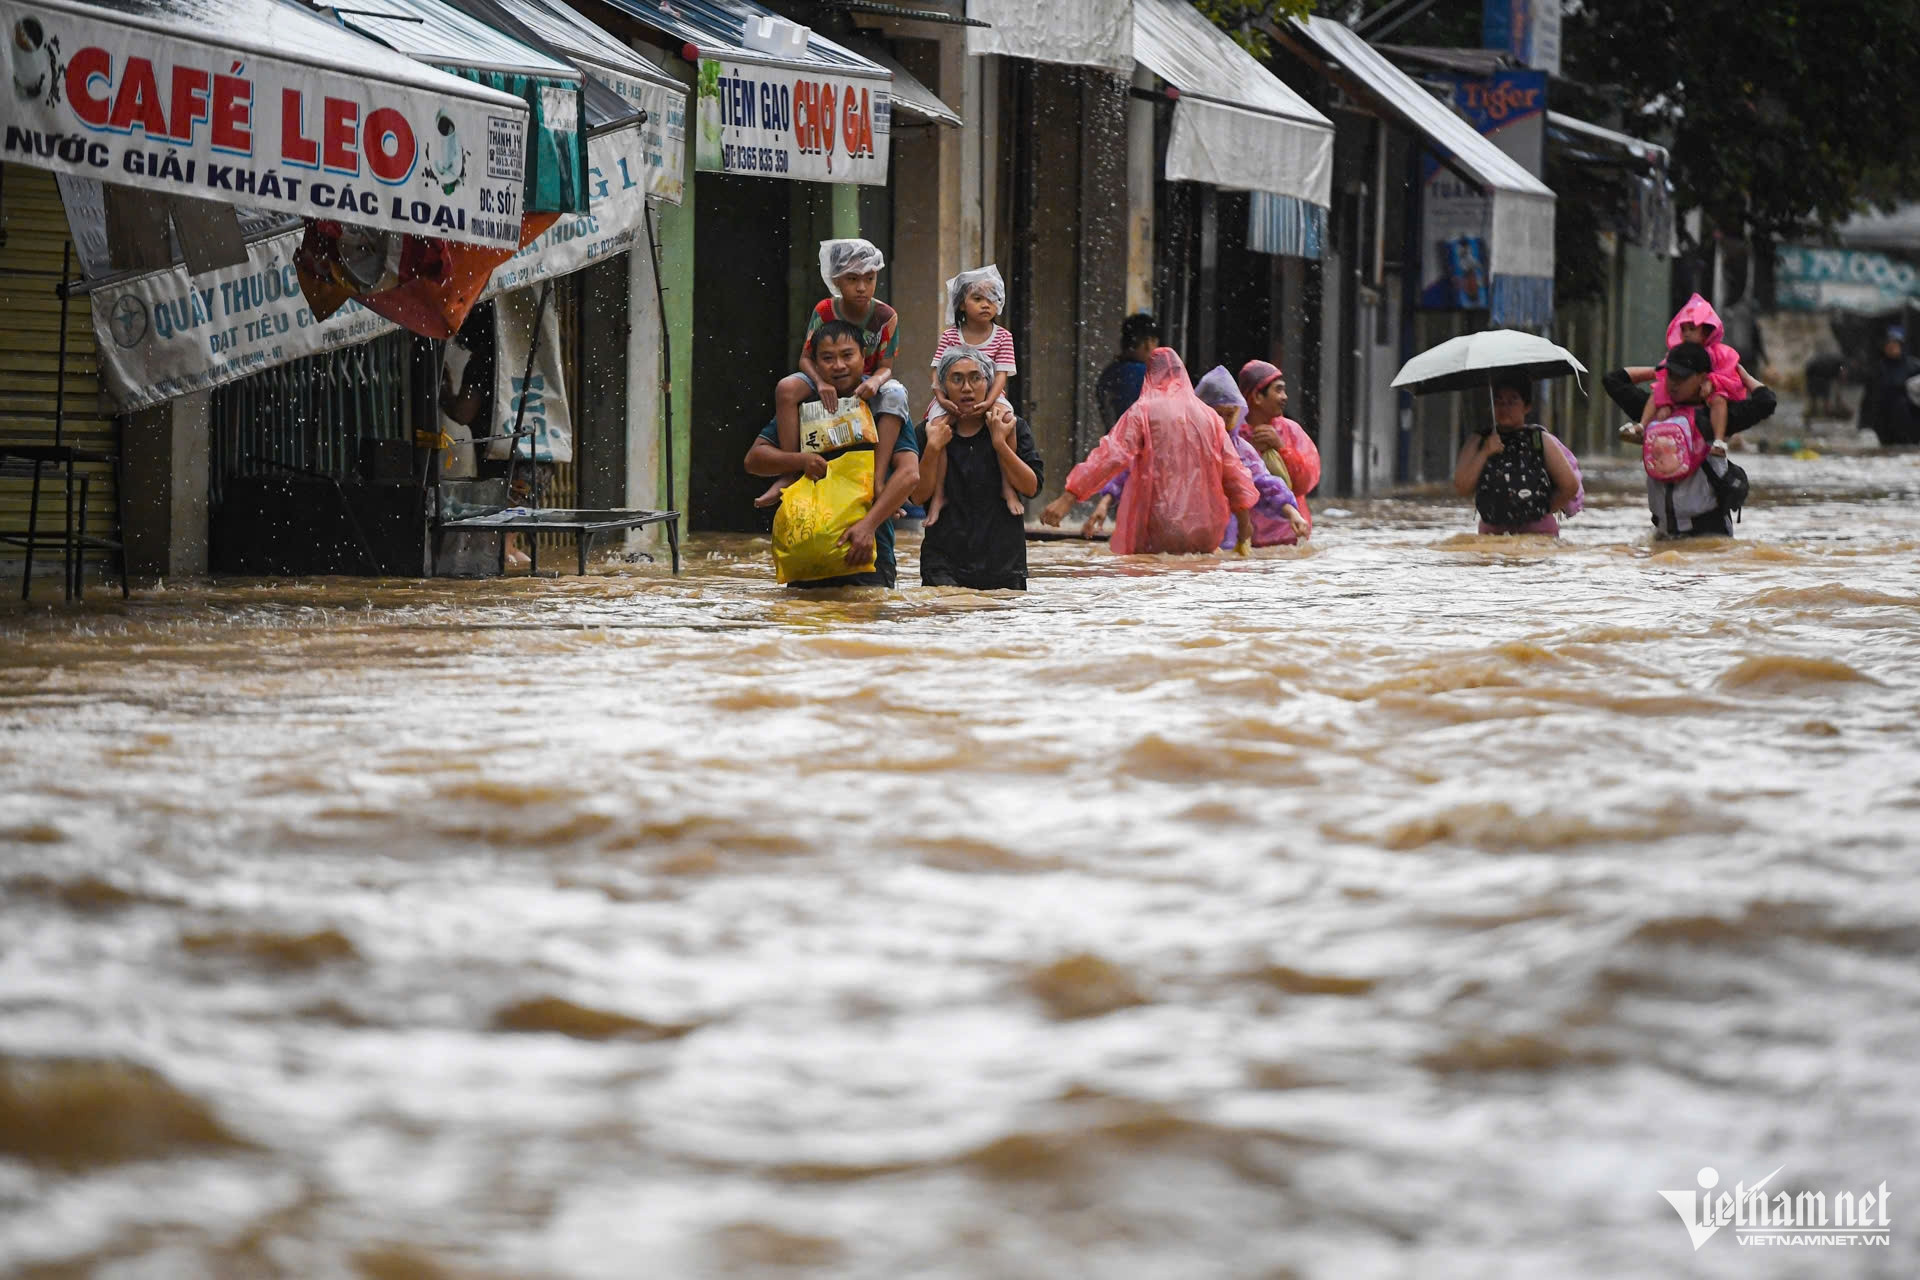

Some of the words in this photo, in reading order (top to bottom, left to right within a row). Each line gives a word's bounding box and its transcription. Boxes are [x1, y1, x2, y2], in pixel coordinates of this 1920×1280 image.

[65, 46, 253, 158] CAFÉ
[281, 88, 418, 187] LEO
[718, 68, 755, 137] TIỆM
[761, 82, 789, 141] GẠO
[793, 79, 838, 174] CHỢ
[843, 85, 874, 159] GA
[1462, 80, 1539, 119] Tiger
[5, 125, 109, 168] NƯỚC
[123, 148, 195, 183] GIẢI
[207, 163, 302, 202] KHÁT
[310, 183, 379, 216] CÁC
[392, 197, 465, 233] LOẠI
[497, 183, 511, 215] SỐ
[220, 256, 300, 316] THUỐC
[209, 327, 237, 355] ĐẠT
[244, 313, 290, 342] TIÊU
